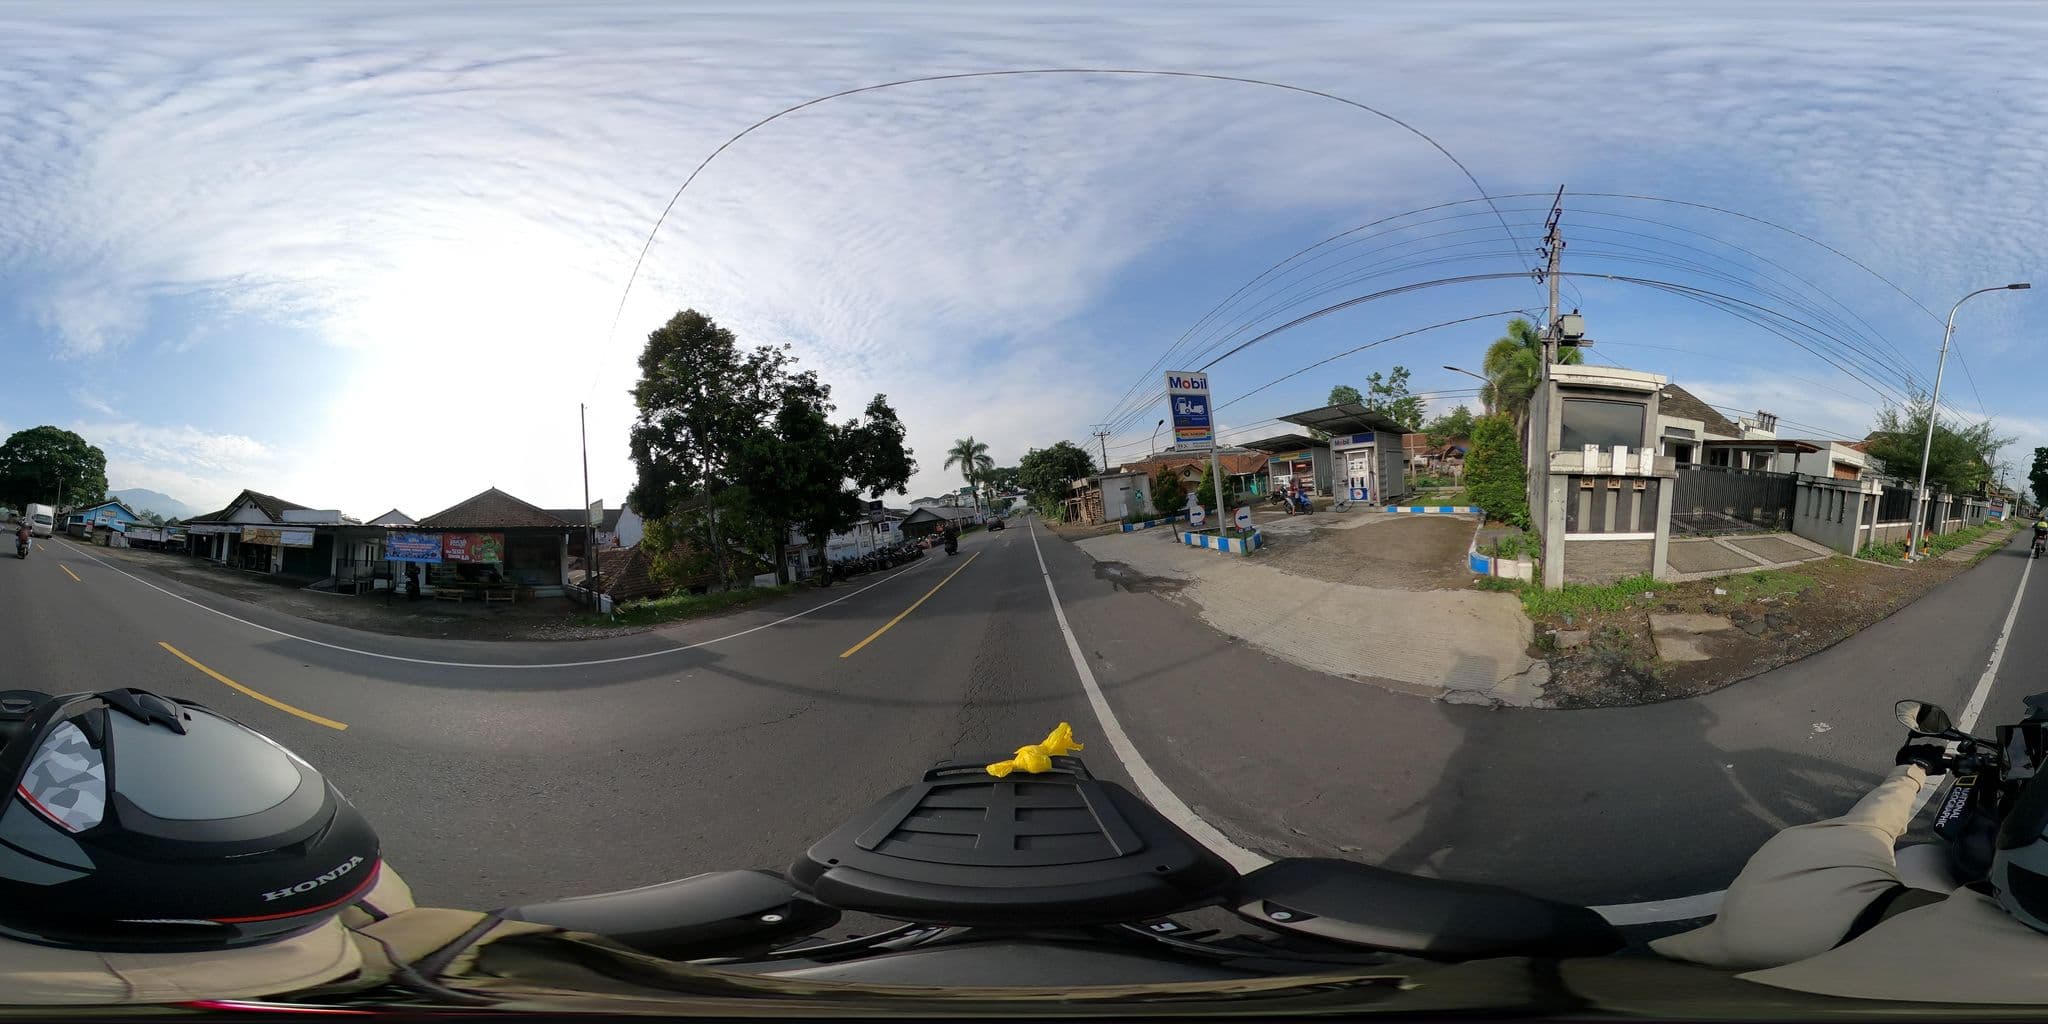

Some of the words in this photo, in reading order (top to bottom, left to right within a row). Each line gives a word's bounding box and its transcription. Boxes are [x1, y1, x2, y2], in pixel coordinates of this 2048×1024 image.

[1169, 376, 1207, 389] Mobil
[1936, 787, 1962, 827] GEOGRAPHIC
[1950, 788, 1970, 819] NATIONAL
[262, 856, 364, 901] HONDA
